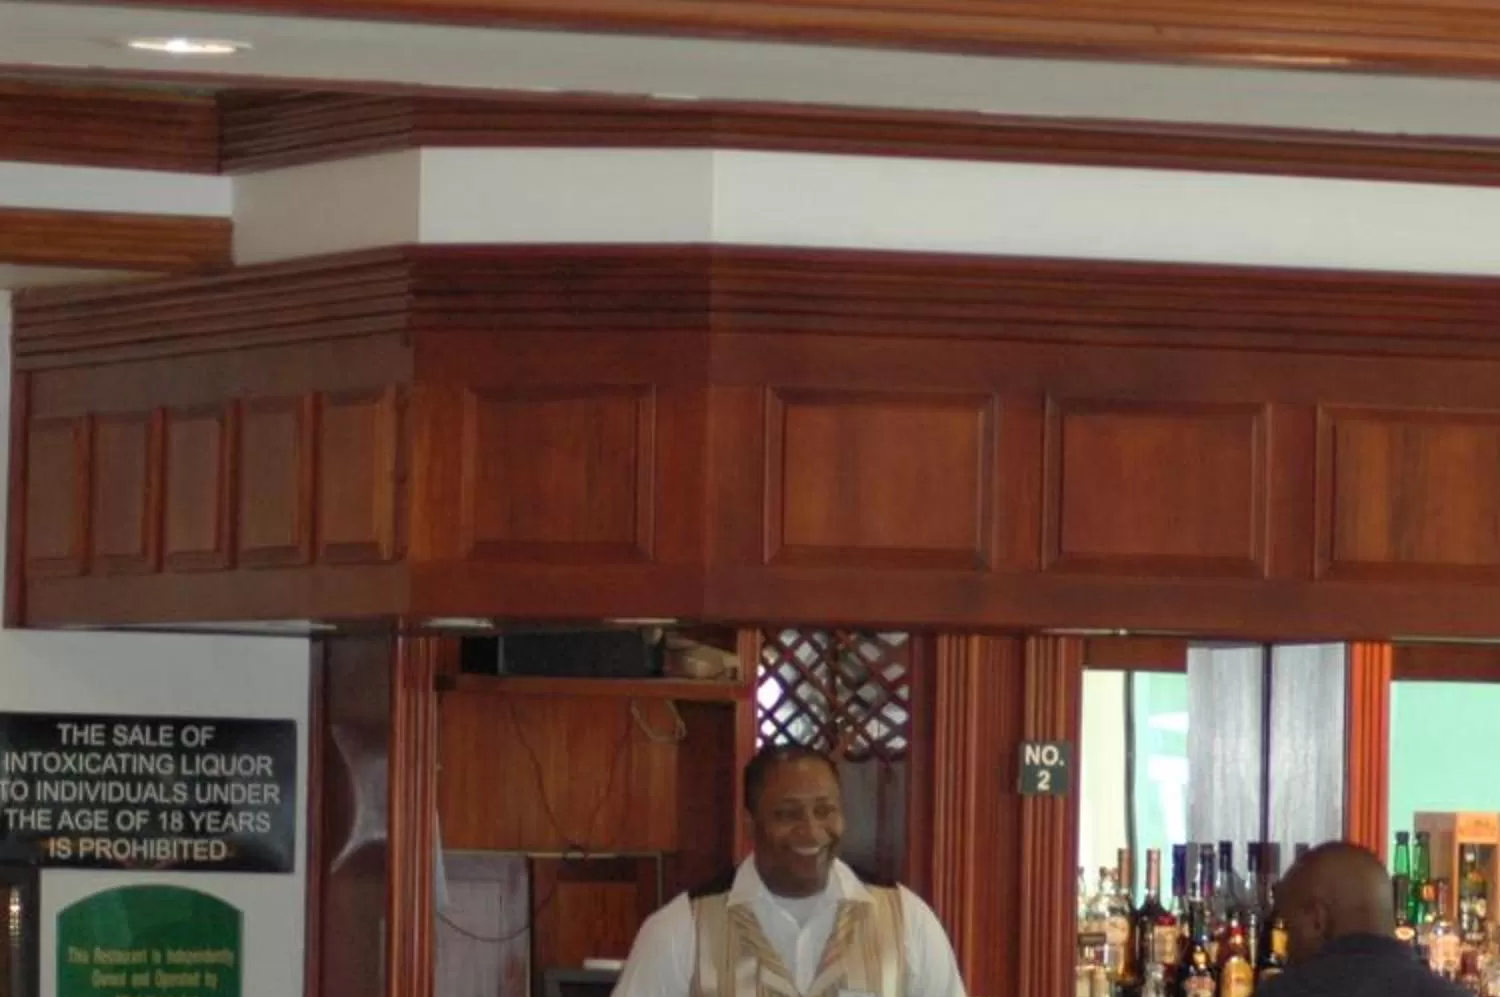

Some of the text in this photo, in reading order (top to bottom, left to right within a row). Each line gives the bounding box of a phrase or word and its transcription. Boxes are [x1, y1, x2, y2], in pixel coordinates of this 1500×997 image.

[57, 722, 216, 747] THE SALE OF
[4, 751, 273, 776] INTOXICATING LIQUOR
[0, 780, 280, 804] TO INDIVIDUALS UNDER
[1036, 769, 1051, 791] 2
[4, 808, 270, 832] THE AGE OF 18 YEARS
[49, 837, 228, 860] IS PROHIBITED
